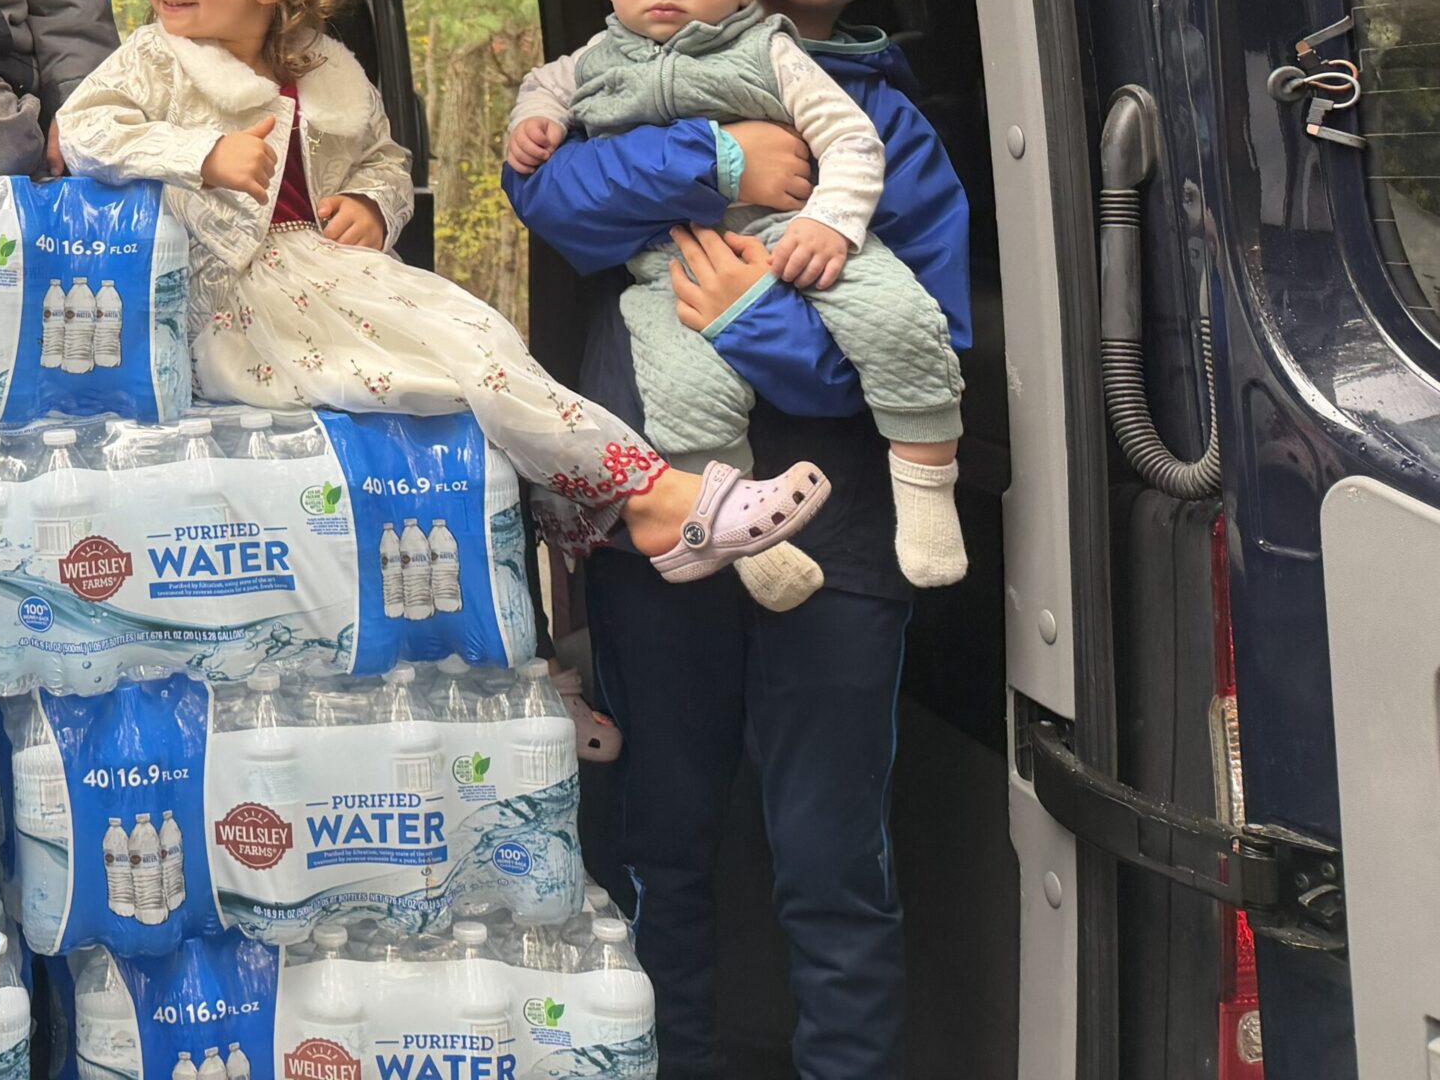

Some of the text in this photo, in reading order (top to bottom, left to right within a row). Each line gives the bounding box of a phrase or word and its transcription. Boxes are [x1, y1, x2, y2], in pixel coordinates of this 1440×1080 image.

[36, 234, 138, 255] 40 16.9 FL OZ
[362, 476, 468, 495] 40 16.9 FL OZ
[174, 522, 260, 541] PURIFIED
[63, 557, 127, 579] WELLSLEY
[147, 540, 290, 578] WATER
[23, 603, 48, 615] 100%
[137, 631, 149, 640] NET
[217, 628, 244, 641] GALLONS
[83, 764, 189, 788] 40 16.9 FL OZ
[332, 793, 421, 809] PURIFIED
[219, 825, 288, 845] WELLSLEY
[306, 811, 445, 847] WATER
[498, 849, 527, 860] 100%
[152, 999, 260, 1024] 40 16.9 FL OZ
[403, 1034, 494, 1051] PURIFIED
[288, 1058, 357, 1080] WELLSLEY
[376, 1053, 516, 1080] WATER
